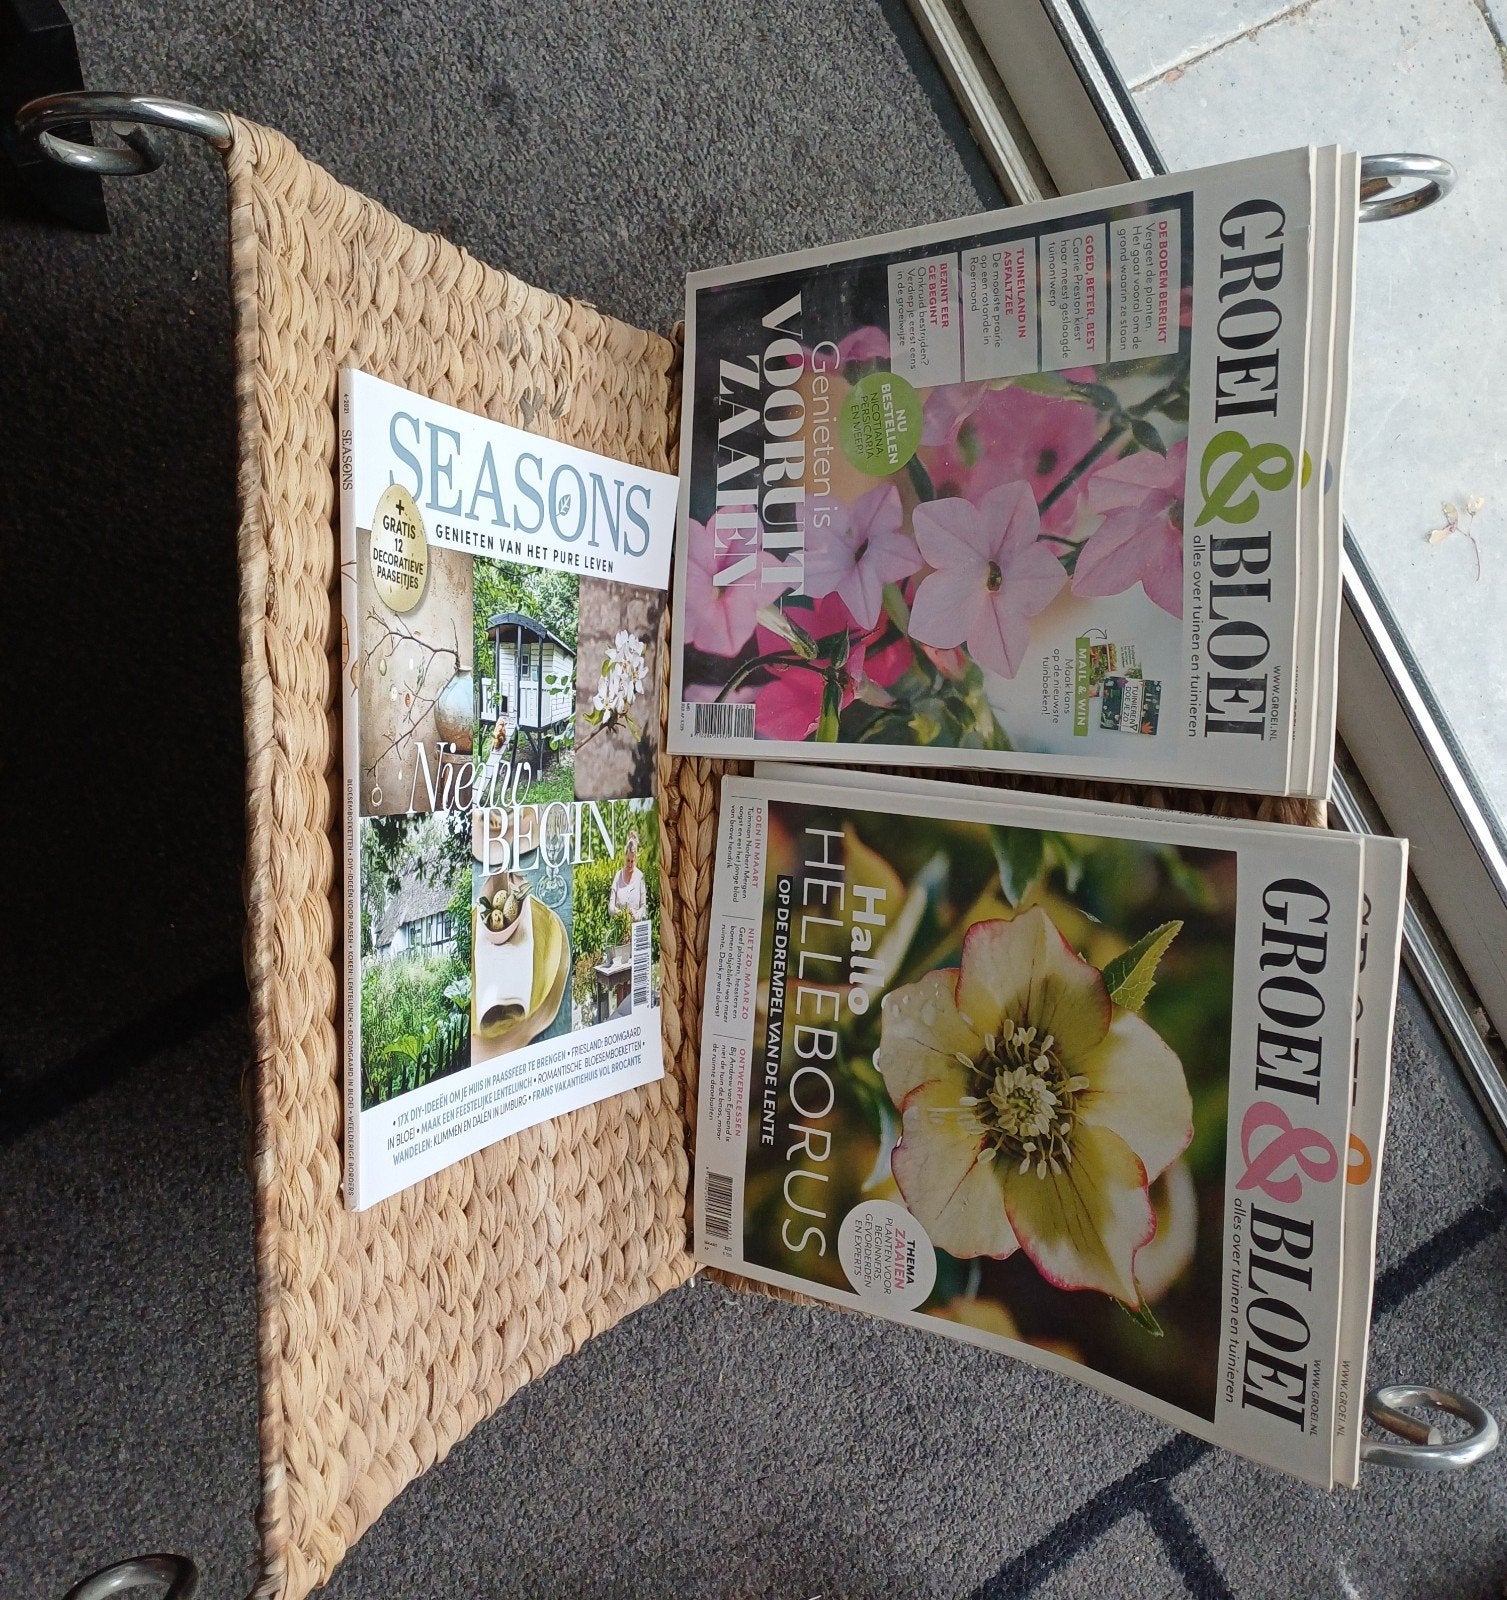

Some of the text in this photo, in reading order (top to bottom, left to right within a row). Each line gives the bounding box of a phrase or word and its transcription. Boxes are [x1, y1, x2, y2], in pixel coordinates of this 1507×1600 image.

[906, 268, 916, 308] Verdiep
[928, 266, 937, 326] GE BEGINT
[940, 263, 949, 328] BEZINT EER
[970, 256, 979, 312] Roermond
[980, 255, 987, 268] op
[1004, 251, 1013, 316] ASFALTZEE
[1016, 248, 1026, 338] TUINEILAND IN
[1046, 242, 1057, 307] tuinontwerp
[1072, 238, 1083, 342] Carrie Preston kiest
[1084, 236, 1095, 352] GOED, BETER, BEST
[1118, 229, 1129, 350] grond waarin ze staan
[1130, 226, 1142, 350] Het gaat vooral om de
[1144, 223, 1156, 332] Vergeet de planten.
[1158, 221, 1168, 344] DE BODEM BEREIKT
[896, 271, 906, 346] in de groeiwijze
[907, 310, 916, 318] je
[908, 321, 916, 344] eerst
[918, 266, 930, 366] Onkruid bestrijden?
[982, 292, 990, 334] rotonde
[992, 252, 1002, 348] De mooiste prairie
[1059, 240, 1071, 358] haar meest geslaagde
[984, 336, 991, 345] in
[811, 340, 840, 528] Genieten is
[851, 405, 861, 420] EN
[860, 396, 874, 460] PERSICARIA
[870, 392, 884, 458] NICOTIANA,
[882, 383, 898, 464] BESTELLEN
[896, 409, 908, 432] NU
[342, 430, 353, 490] SEASONS
[389, 411, 651, 558] SEASONS
[712, 354, 760, 590] ZAAIEN
[1194, 199, 1294, 742] GROEI & BLOEI
[373, 548, 423, 575] DECORATIEVE
[383, 515, 416, 539] GRATIS
[394, 538, 402, 553] 12
[435, 524, 614, 573] GENIETEN VAN HET PURE LEVEN
[377, 566, 418, 590] PAASEITJES
[1188, 535, 1205, 738] alles over tuinen en tuinieren
[1042, 656, 1050, 716] tuinboeken!
[1052, 648, 1062, 724] op de nieuwste
[1064, 658, 1074, 714] Maak kans
[1077, 648, 1087, 726] MAIL & WIN
[1129, 686, 1139, 724] TUINIEREN
[1269, 665, 1282, 742] WWW.GROEI.NL
[406, 741, 531, 815] Nieuw
[478, 800, 617, 878] BEGIN
[752, 852, 760, 888] MAART
[754, 839, 761, 849] IN
[848, 884, 886, 1016] Hallo
[742, 1006, 748, 1020] ZO
[762, 879, 791, 1146] OP DE DREMPEL VAN DE LENTE
[781, 828, 846, 1257] HELLEBORUS
[388, 1040, 642, 1150] IN BLOEI MAAK EEN FEESTELIJKE LENTELUNCH ROMANTISCHE BLOESEMBOEKETTEN
[392, 1054, 642, 1166] WANDELEN: KLIMMEN EN DALEN IN LIMBURG FRANS VAKANTIEHUIS VOL BROCANTE
[398, 1026, 641, 1128] 17X DIY-IDEEËN OM JE HUIS IN PAASSFEER TE BRENGEN FRIESLAND: BOOMGAARD
[735, 1048, 746, 1136] ONTWERPLESSEN
[1235, 878, 1339, 1432] GROEI & BLOEI
[854, 1220, 862, 1276] EN EXPERTS
[864, 1214, 873, 1288] GEVORDERDEN
[873, 1225, 882, 1280] BEGINNERS,
[884, 1218, 893, 1294] PLANTEN VOOR
[894, 1228, 906, 1290] ZAAIEN
[906, 1240, 916, 1284] THEMA
[1224, 1198, 1246, 1404] alles over tuinen en tuinieren
[1310, 1359, 1322, 1436] WWW.GROEI.NL
[1336, 1360, 1351, 1437] WWW.GROEI.NL
